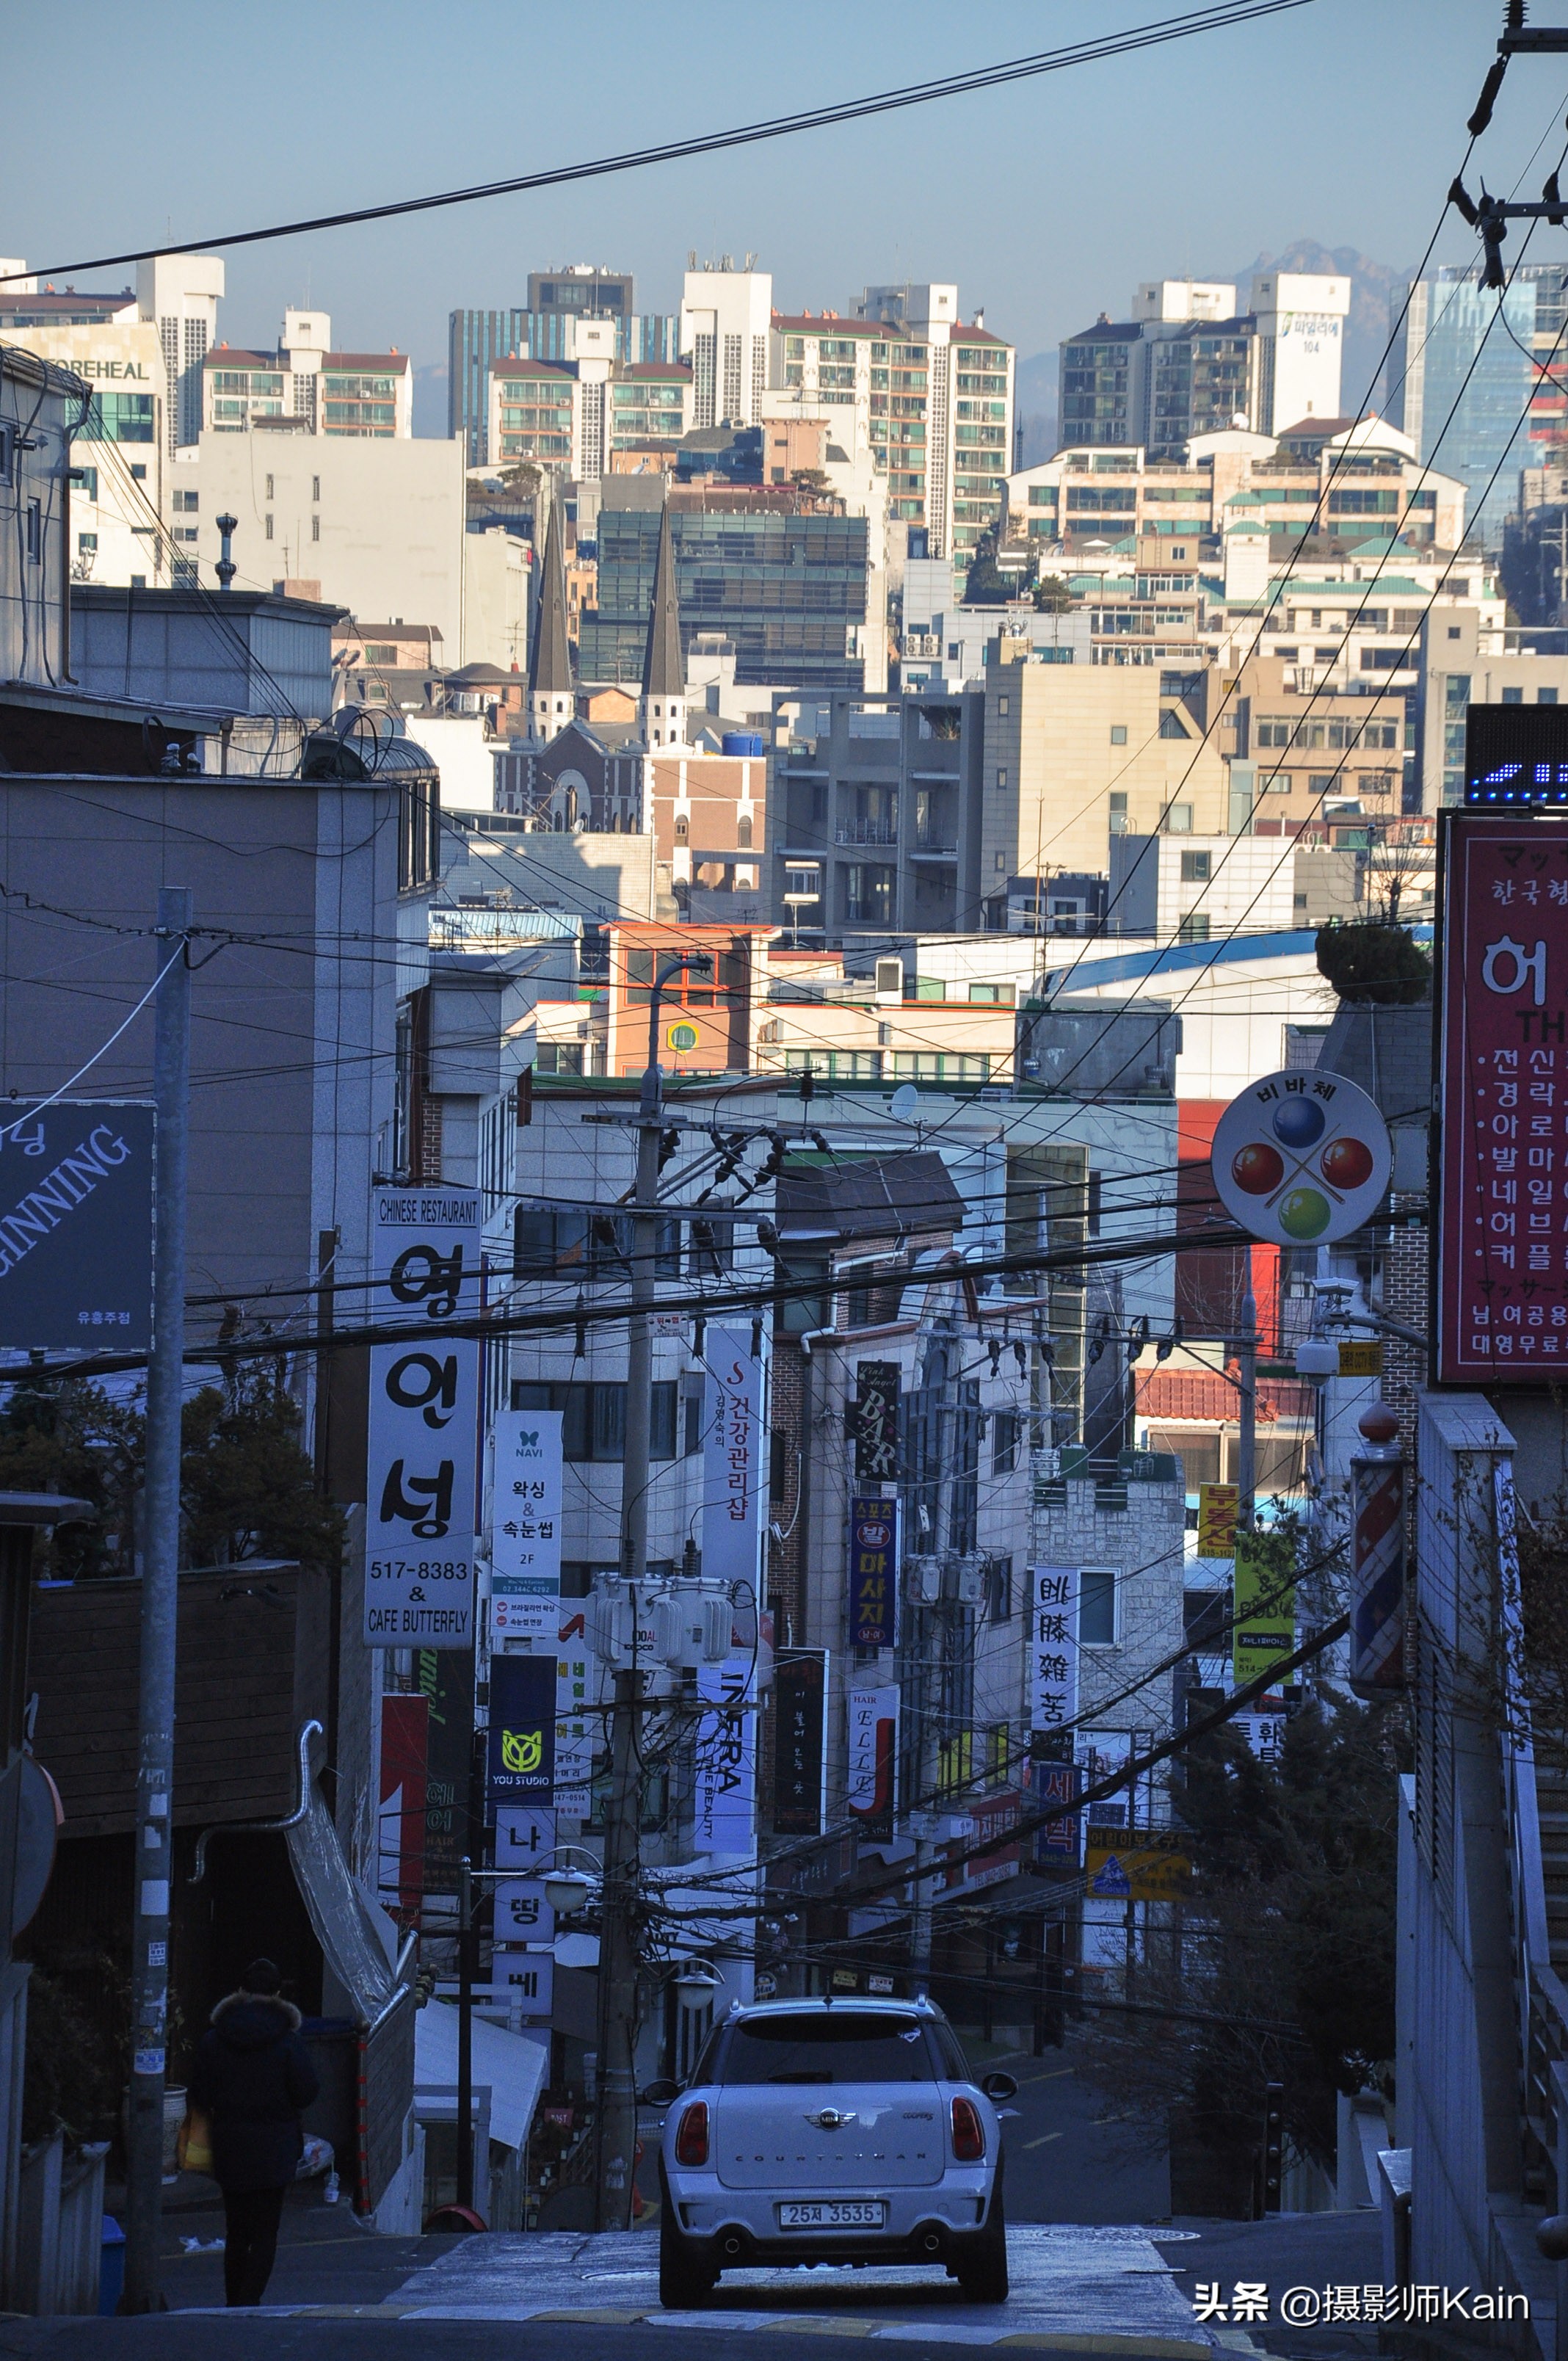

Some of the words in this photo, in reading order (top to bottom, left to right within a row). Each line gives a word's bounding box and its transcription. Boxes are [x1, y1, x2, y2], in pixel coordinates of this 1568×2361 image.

[1304, 341, 1320, 353] 104
[1492, 1049, 1568, 1075] 전신
[1256, 1077, 1337, 1103] 비바체
[1492, 1081, 1568, 1107] 경락
[0, 1122, 46, 1156] 닝
[1492, 1114, 1568, 1139] 아로
[1492, 1147, 1568, 1172] 발마
[1492, 1180, 1568, 1205] 네일
[379, 1199, 417, 1224] CHINESE
[421, 1199, 478, 1223] RESTAURANT
[1490, 1211, 1568, 1237] 허브
[1490, 1244, 1568, 1270] 커플
[77, 1311, 131, 1325] 유흥주점
[857, 1388, 896, 1479] BAR
[516, 1448, 542, 1458] NAVI
[726, 1396, 750, 1522] 건강관리샵
[512, 1481, 545, 1499] 왁싱
[522, 1502, 534, 1517] &
[856, 1501, 893, 1520] 스포츠
[1205, 1487, 1237, 1548] 부동산
[502, 1521, 553, 1539] 속눈썹
[370, 1562, 468, 1580] 517-8383
[519, 1553, 534, 1565] 2F
[409, 1586, 427, 1602] &
[857, 1552, 888, 1625] 마사지
[369, 1609, 398, 1632] CAFE
[402, 1609, 468, 1633] BUTTERFLY
[853, 1696, 877, 1705] HAIR
[856, 1710, 873, 1792] ELLE
[493, 1776, 514, 1786] YOU
[515, 1776, 550, 1787] STUDIO
[703, 1788, 714, 1839] BEAUTY
[1045, 1771, 1078, 1853] 세탁
[426, 1836, 455, 1846] HAIR
[735, 2153, 926, 2162] COUNTRYMAN
[788, 2206, 822, 2223] 25저
[830, 2205, 874, 2222] 3535
